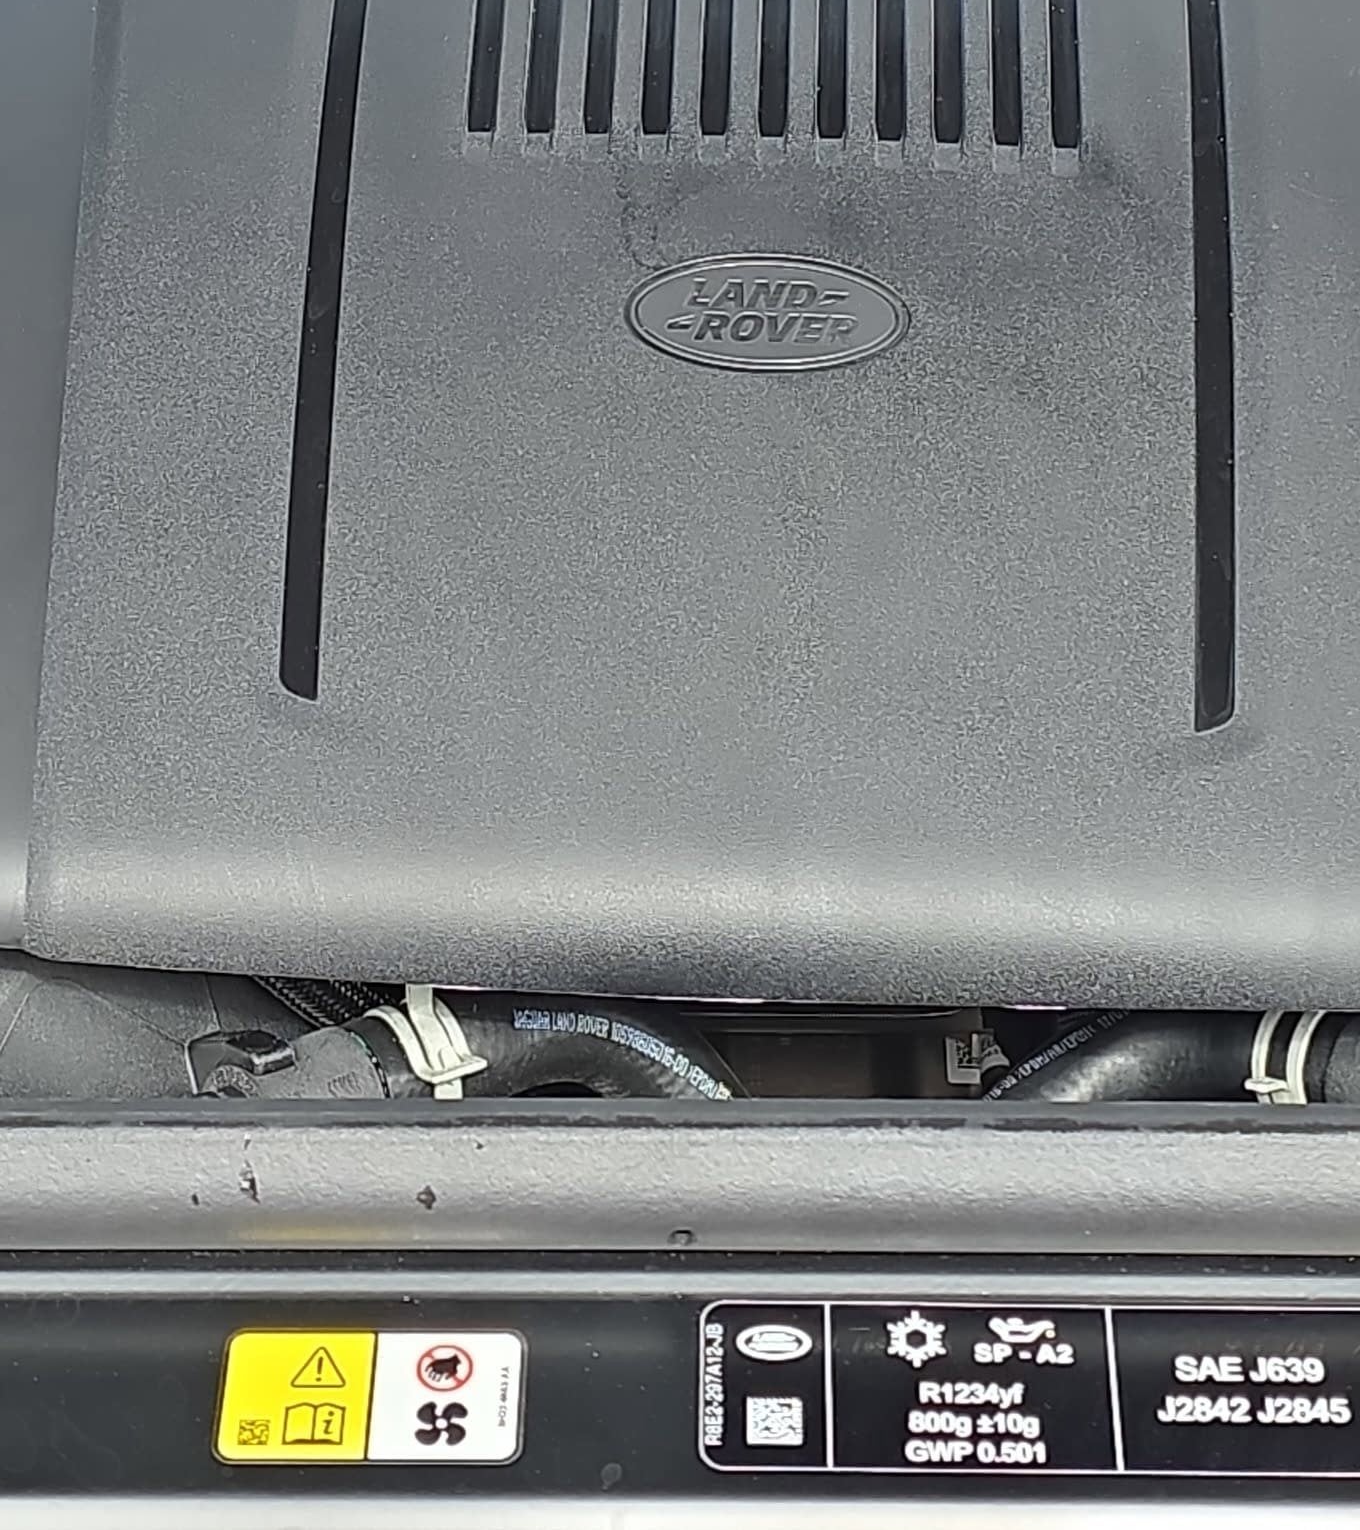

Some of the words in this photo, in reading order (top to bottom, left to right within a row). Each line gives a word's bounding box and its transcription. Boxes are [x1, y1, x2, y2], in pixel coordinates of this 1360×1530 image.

[687, 277, 819, 309] LAND
[692, 309, 859, 343] ROVER
[552, 1010, 577, 1033] LAND
[576, 1014, 610, 1039] ROVER
[973, 1343, 1013, 1363] SP
[1035, 1343, 1075, 1365] A2
[1174, 1355, 1244, 1382] SAE
[1249, 1357, 1325, 1383] J639
[918, 1381, 1025, 1409] R1234yf
[1157, 1395, 1252, 1423] J2842
[1256, 1397, 1352, 1424] J2845
[907, 1410, 973, 1438] 800g
[976, 1412, 1040, 1439] ±10g
[904, 1440, 974, 1463] GWP
[976, 1440, 1047, 1464] 0.501
